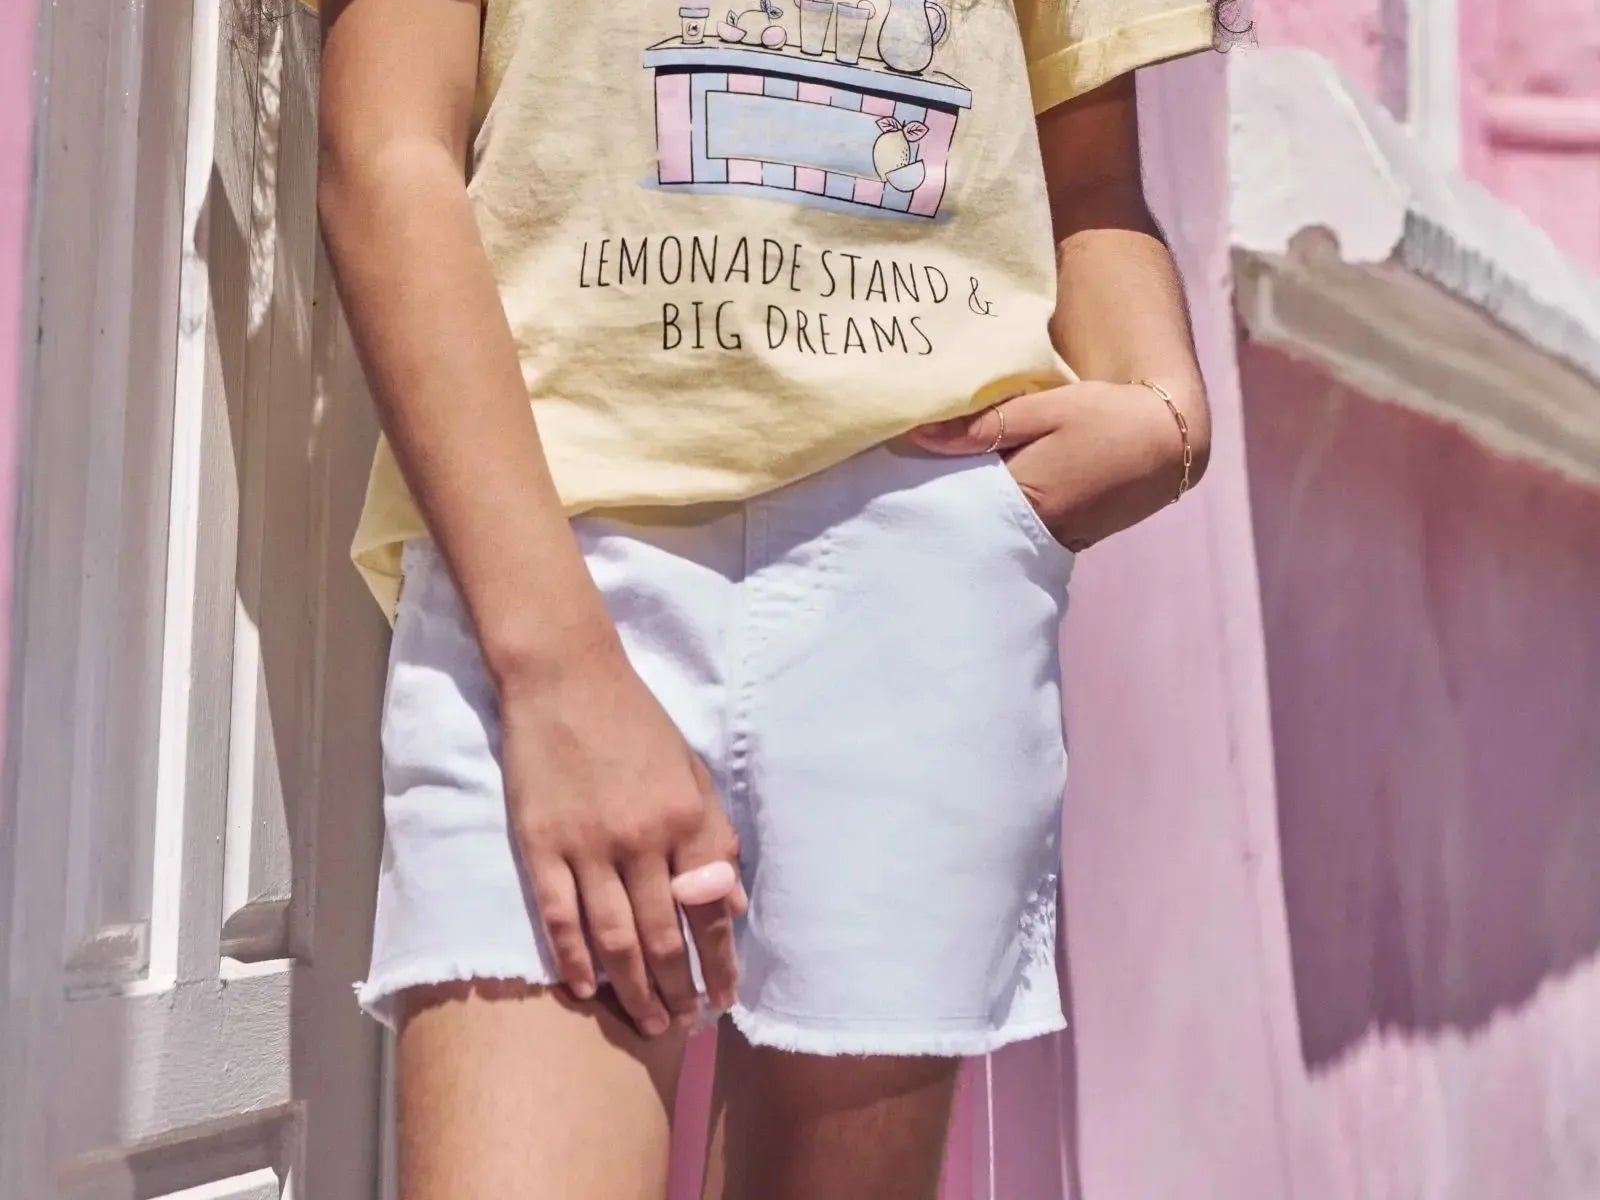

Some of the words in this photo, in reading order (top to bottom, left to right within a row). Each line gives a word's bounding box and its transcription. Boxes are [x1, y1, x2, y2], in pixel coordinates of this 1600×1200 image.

[579, 234, 802, 292] LEMONADE
[820, 249, 949, 304] STAND
[967, 276, 998, 317] &
[662, 300, 742, 350] BIG
[766, 304, 933, 356] DREAMS
